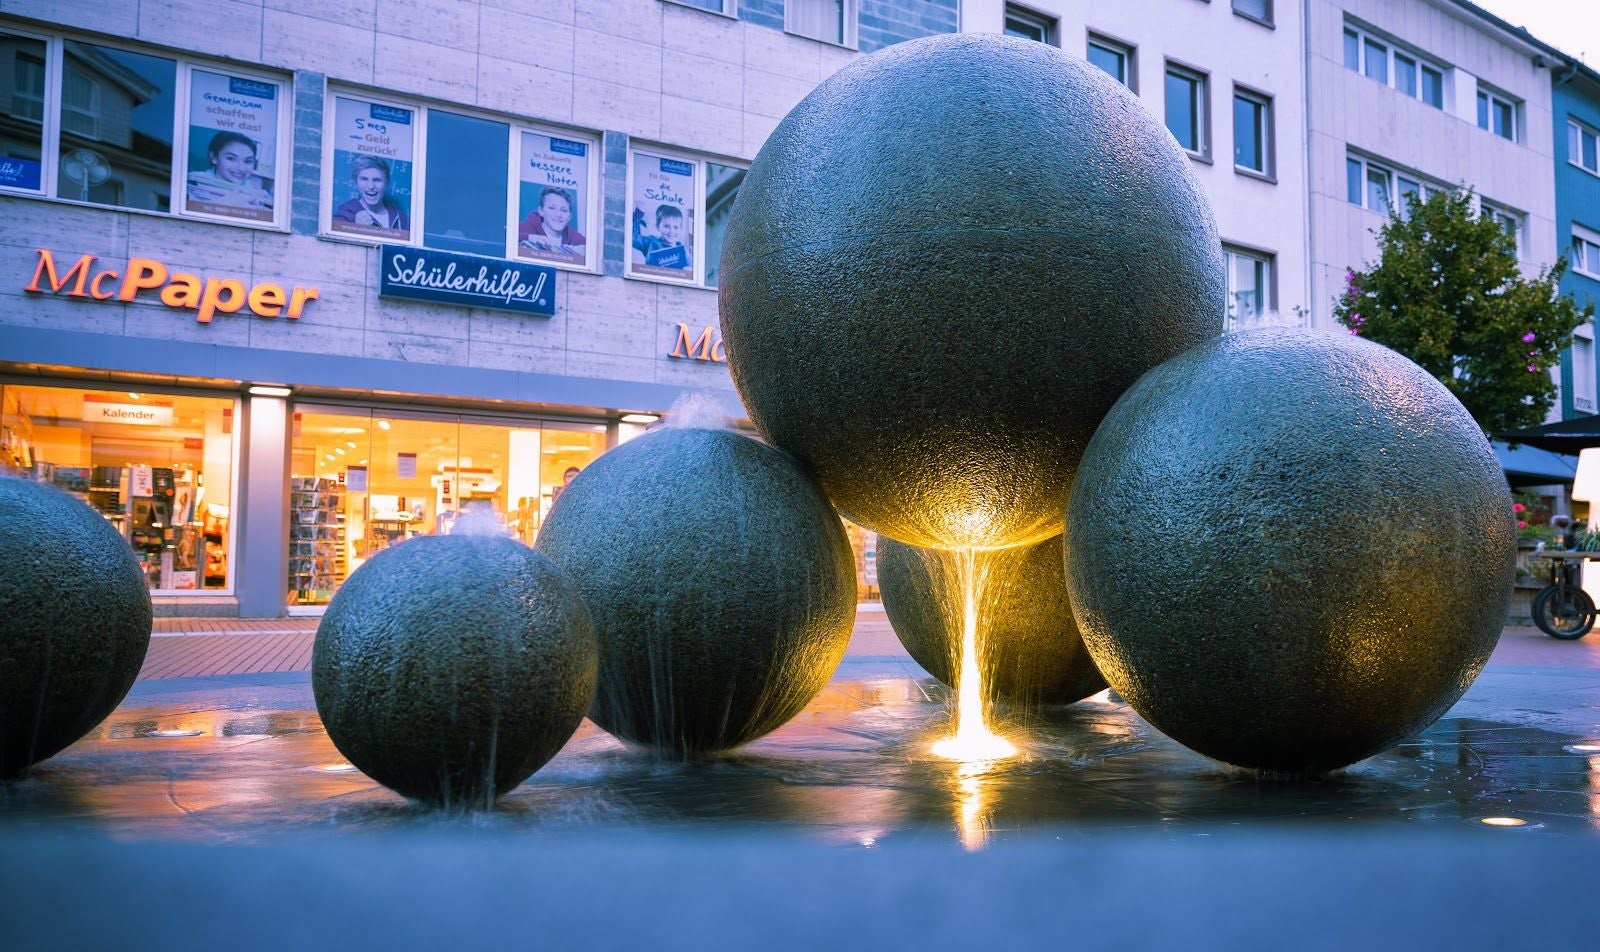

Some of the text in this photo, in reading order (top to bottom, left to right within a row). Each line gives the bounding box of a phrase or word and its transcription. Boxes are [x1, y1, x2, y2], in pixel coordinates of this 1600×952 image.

[203, 92, 262, 110] Gemeinsam
[206, 106, 255, 120] schaffen
[216, 119, 262, 133] wir das!
[365, 134, 390, 145] Geld
[357, 143, 396, 156] zurück!
[530, 159, 572, 175] bessere
[547, 173, 578, 187] Noten
[659, 182, 671, 191] die
[644, 188, 684, 205] Schule
[24, 248, 320, 323] McPaper
[103, 408, 155, 420] Kalender
